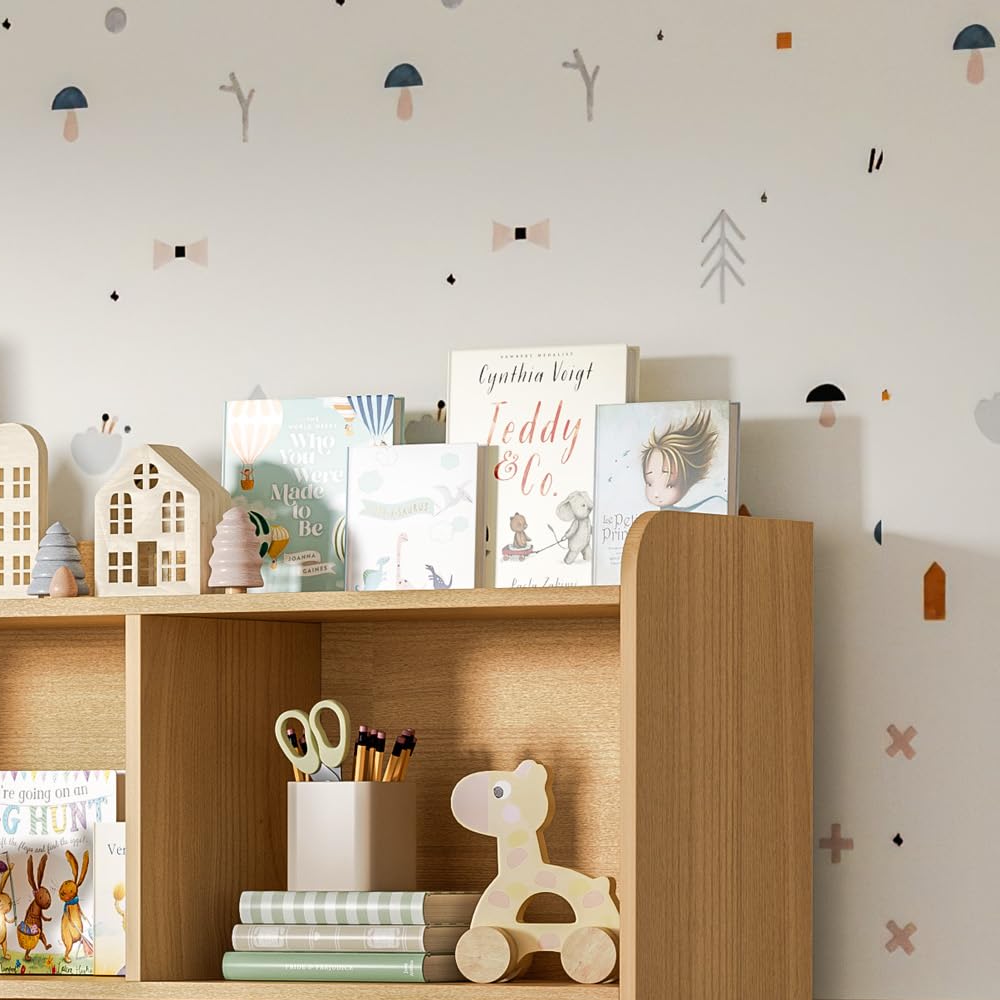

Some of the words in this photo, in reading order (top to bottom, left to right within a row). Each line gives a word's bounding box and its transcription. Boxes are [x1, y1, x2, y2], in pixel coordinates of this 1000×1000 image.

[478, 362, 545, 395] Cynthia
[552, 360, 594, 392] Voigt
[487, 399, 582, 465] Teddy
[289, 432, 336, 456] Who
[279, 448, 316, 465] You
[293, 467, 345, 483] Were
[493, 450, 519, 481] &
[521, 452, 558, 497] Co.
[271, 483, 325, 507] Made
[292, 503, 311, 520] to
[602, 514, 613, 524] Le
[298, 520, 324, 537] Be
[287, 552, 317, 562] JOANNA
[302, 565, 328, 574] GAINES
[18, 787, 51, 803] going
[55, 786, 71, 799] on
[74, 784, 89, 797] an
[28, 796, 109, 836] HUNT
